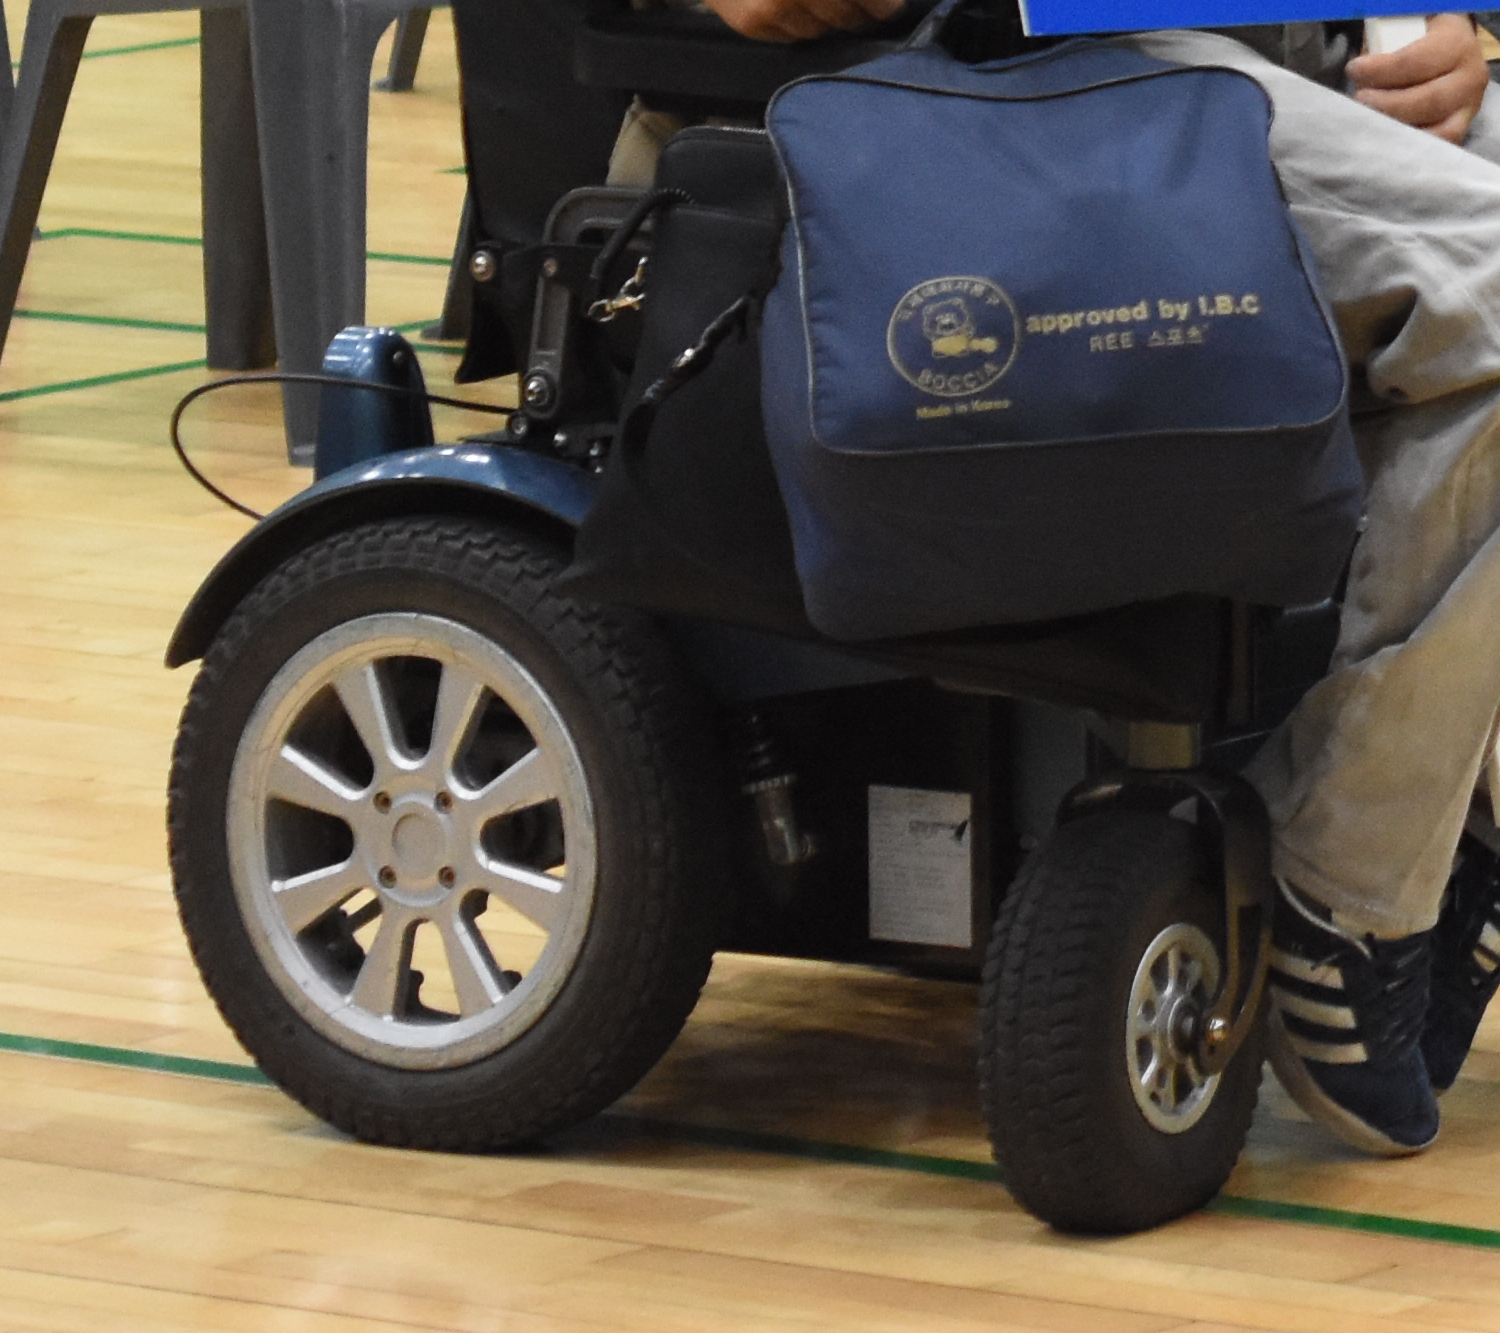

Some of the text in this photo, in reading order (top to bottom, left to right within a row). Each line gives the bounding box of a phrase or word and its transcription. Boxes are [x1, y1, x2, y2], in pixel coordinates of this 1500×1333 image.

[1026, 292, 1261, 333] approved by I.B.C
[918, 362, 999, 392] BOCCIA
